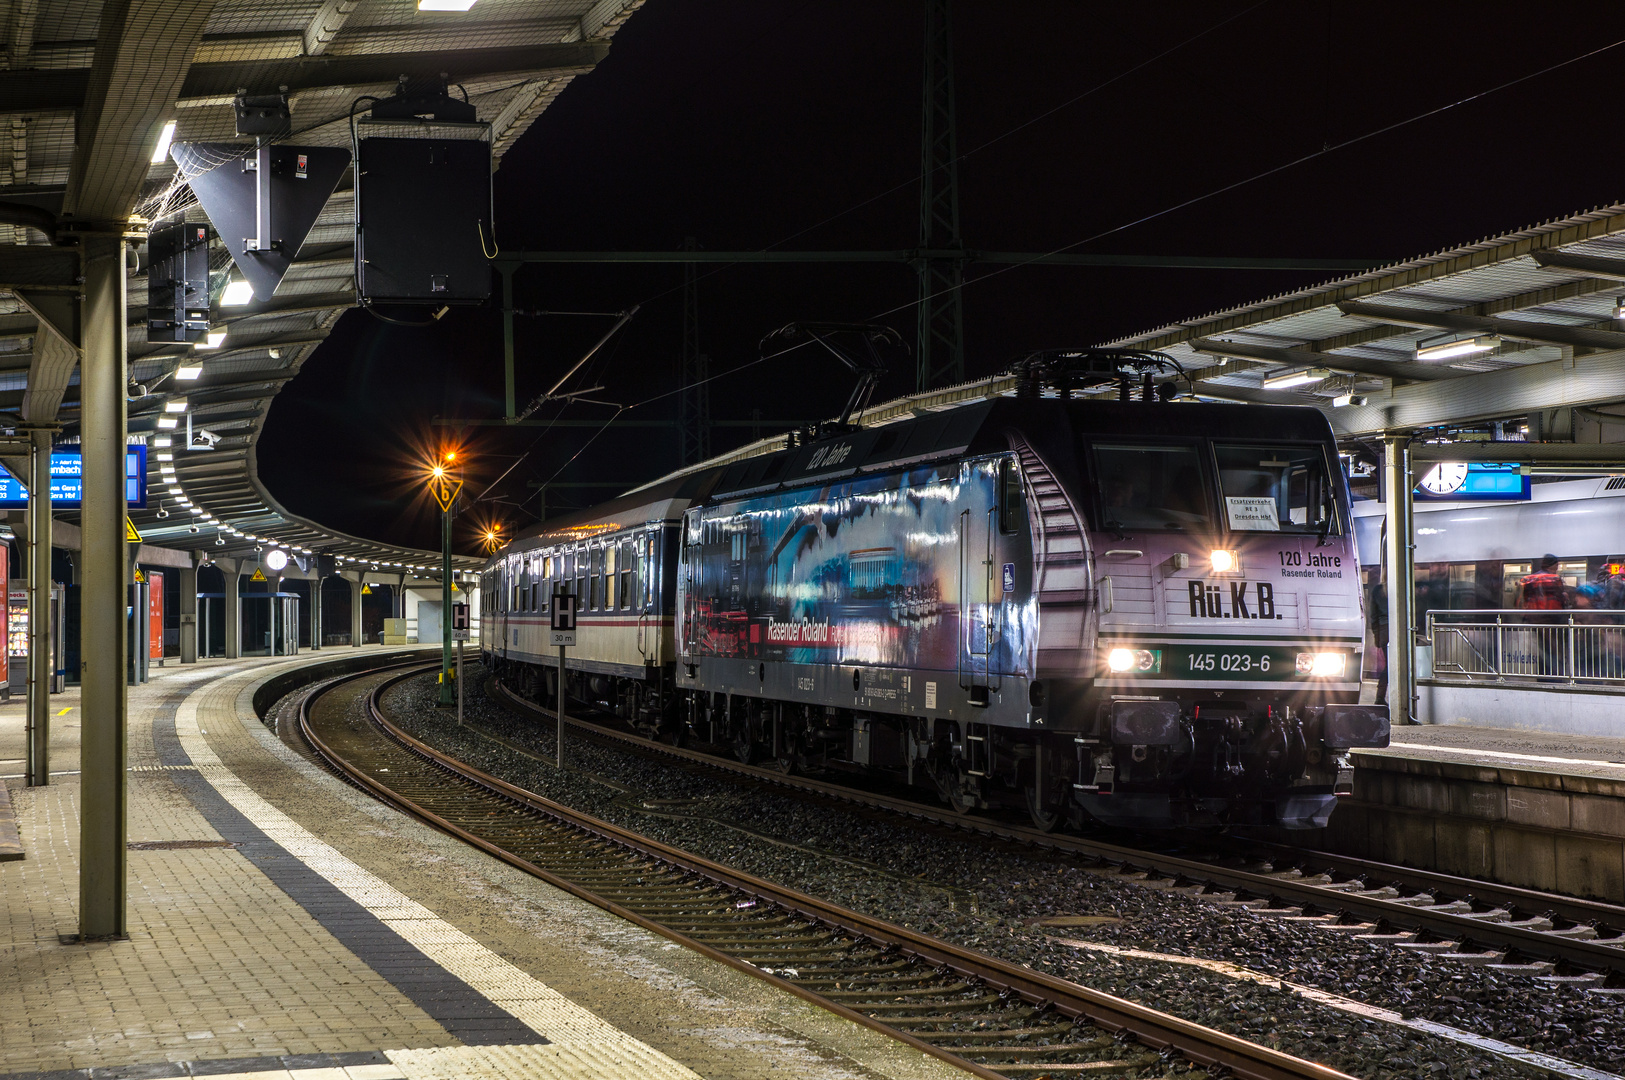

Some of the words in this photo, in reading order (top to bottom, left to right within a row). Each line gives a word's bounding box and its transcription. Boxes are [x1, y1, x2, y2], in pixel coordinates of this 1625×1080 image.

[806, 446, 829, 470] 120
[821, 442, 852, 467] Jahre
[441, 485, 450, 501] 6
[491, 543, 497, 552] 6
[1278, 551, 1301, 566] 120
[1306, 551, 1341, 567] Jahre
[1281, 568, 1315, 578] Rasender
[1317, 569, 1342, 579] Roland
[1188, 580, 1283, 620] Rü.K.B.
[454, 606, 469, 628] H
[554, 597, 574, 628] H
[768, 616, 800, 640] Rasender
[802, 616, 828, 642] Roland
[1188, 653, 1215, 671] 145
[1220, 654, 1271, 672] 023-6
